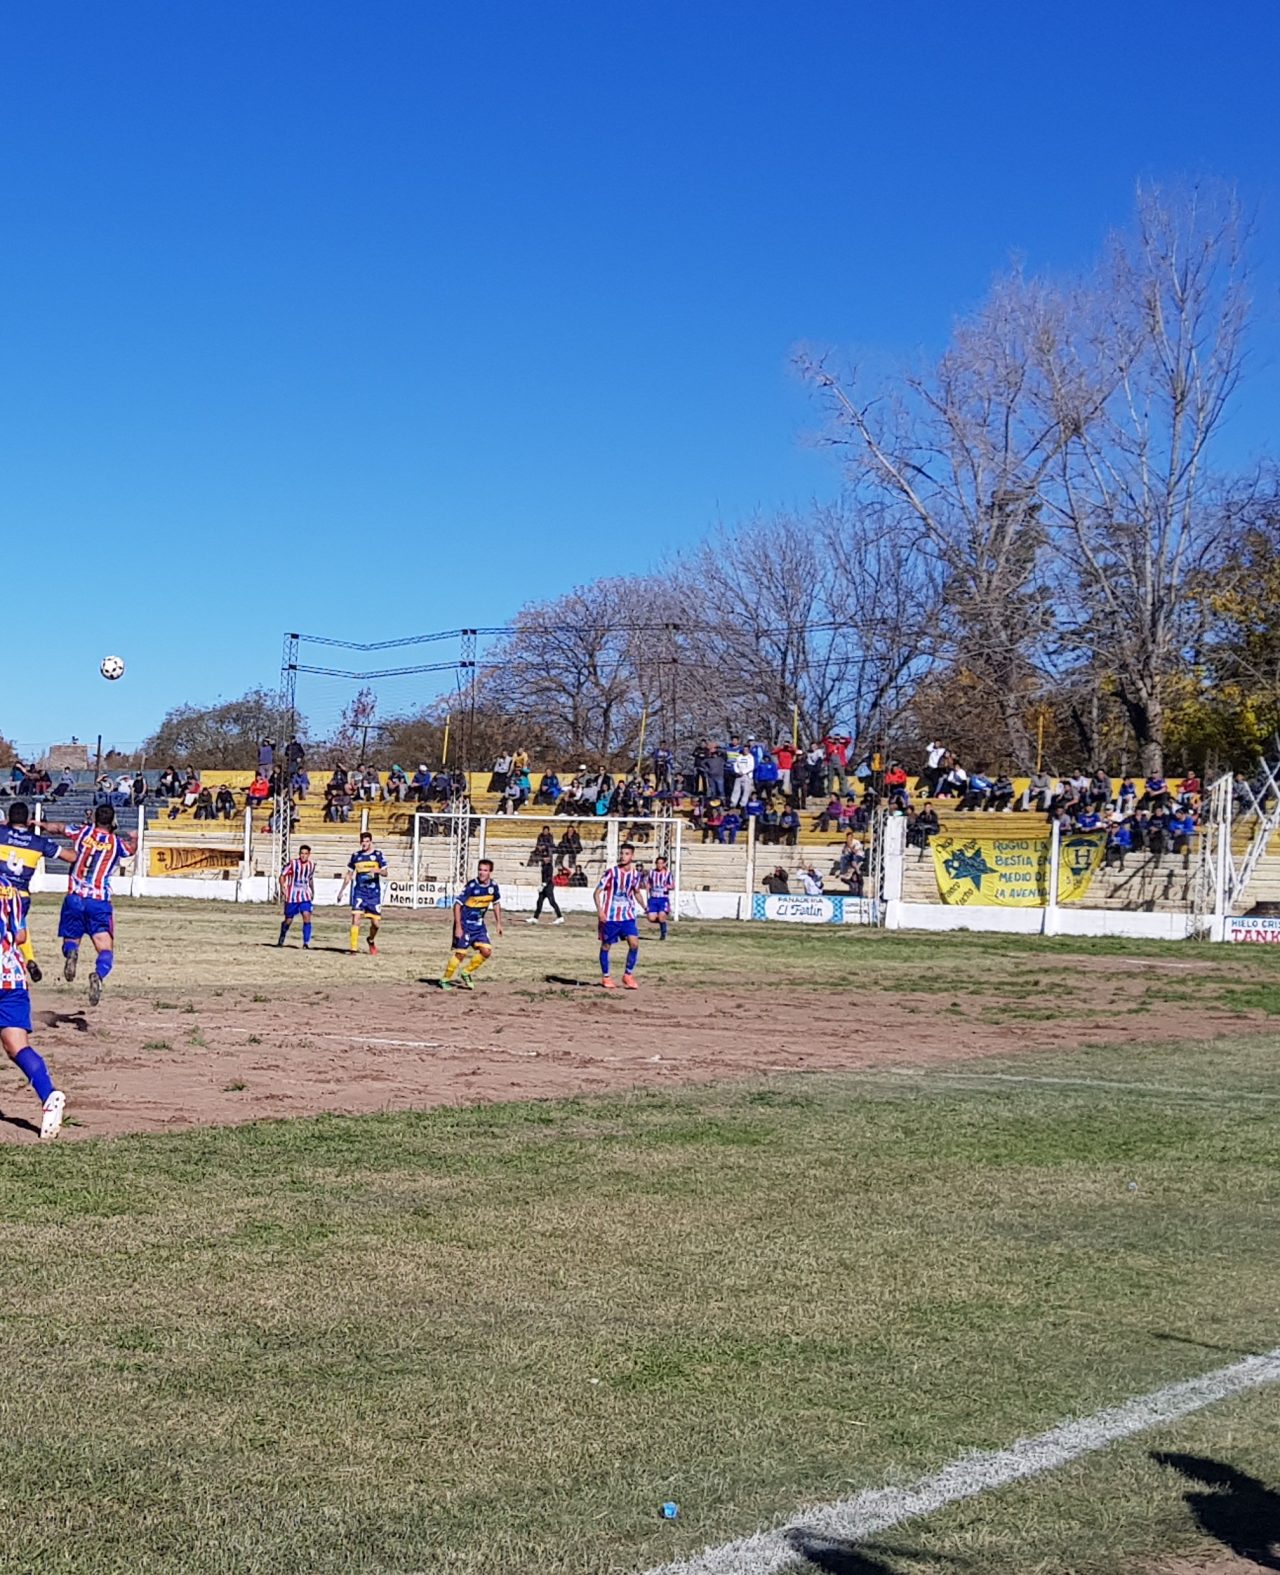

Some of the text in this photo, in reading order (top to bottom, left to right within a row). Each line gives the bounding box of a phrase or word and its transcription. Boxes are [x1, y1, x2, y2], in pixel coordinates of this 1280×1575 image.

[995, 855, 1033, 867] BESTIA
[999, 871, 1031, 883] MEDIO
[389, 881, 436, 893] Quinela
[1231, 919, 1258, 928] HIELO
